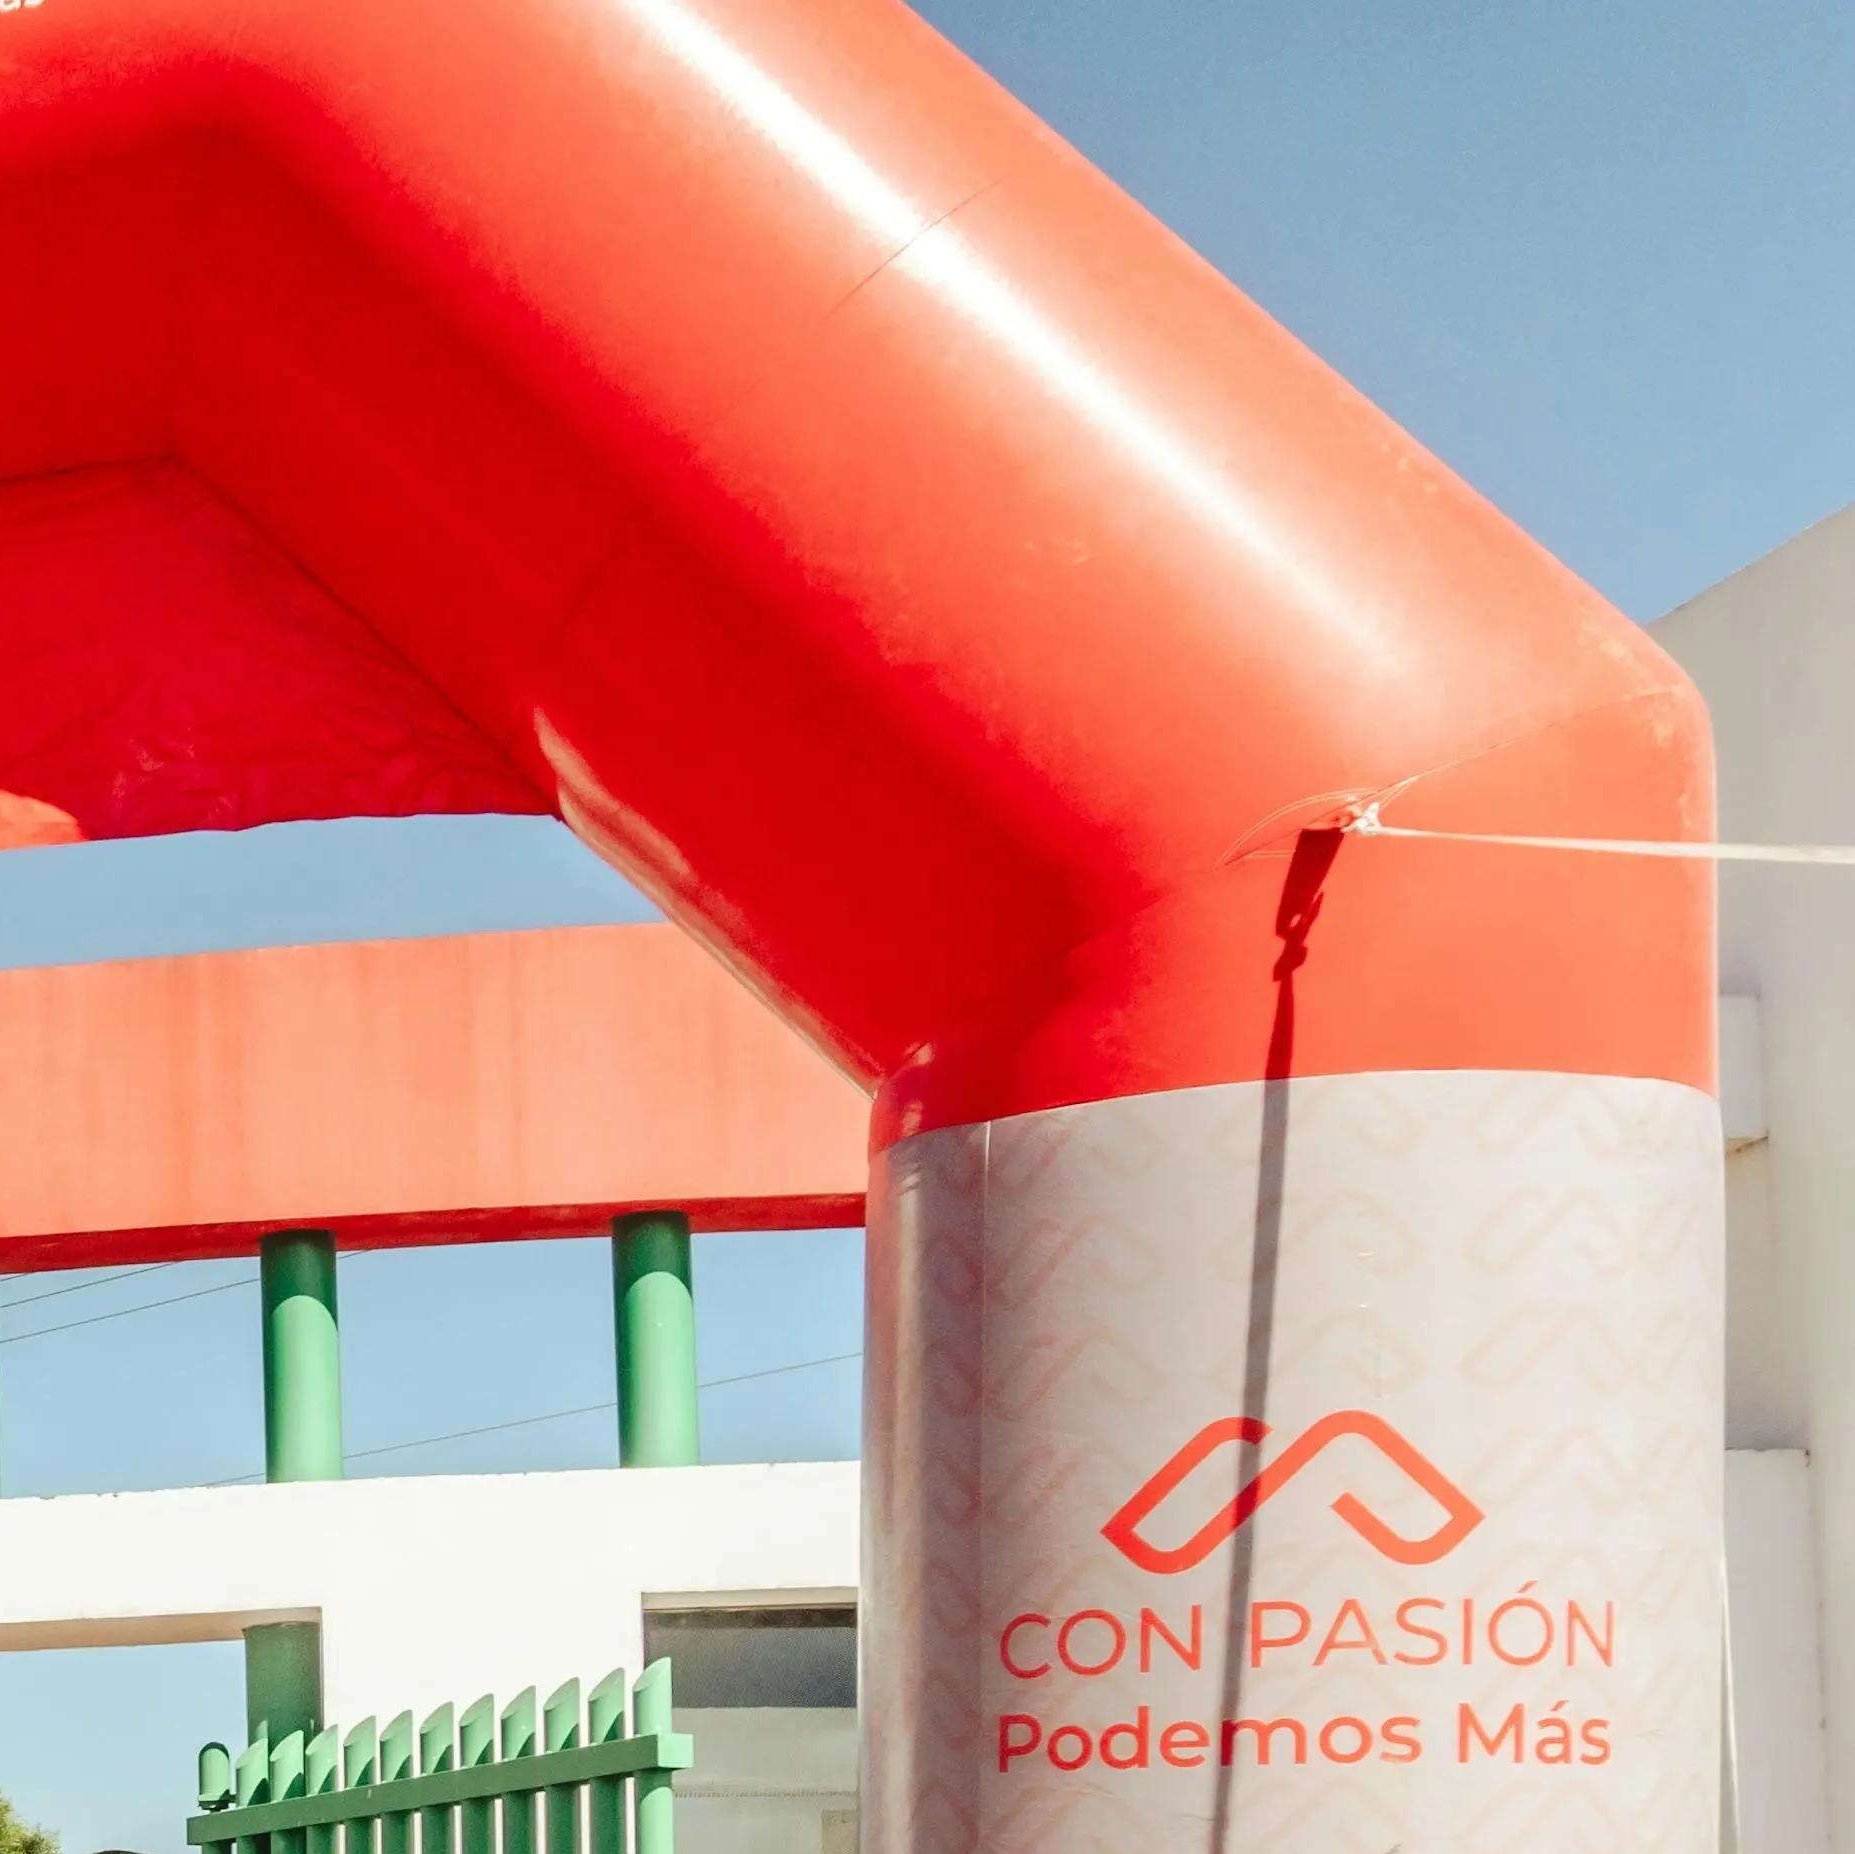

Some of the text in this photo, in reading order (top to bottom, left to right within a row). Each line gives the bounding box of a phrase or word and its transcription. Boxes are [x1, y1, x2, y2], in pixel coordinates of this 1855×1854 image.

[999, 1580, 1614, 1679] CON PASIÓN
[998, 1700, 1612, 1773] Podemos Más
